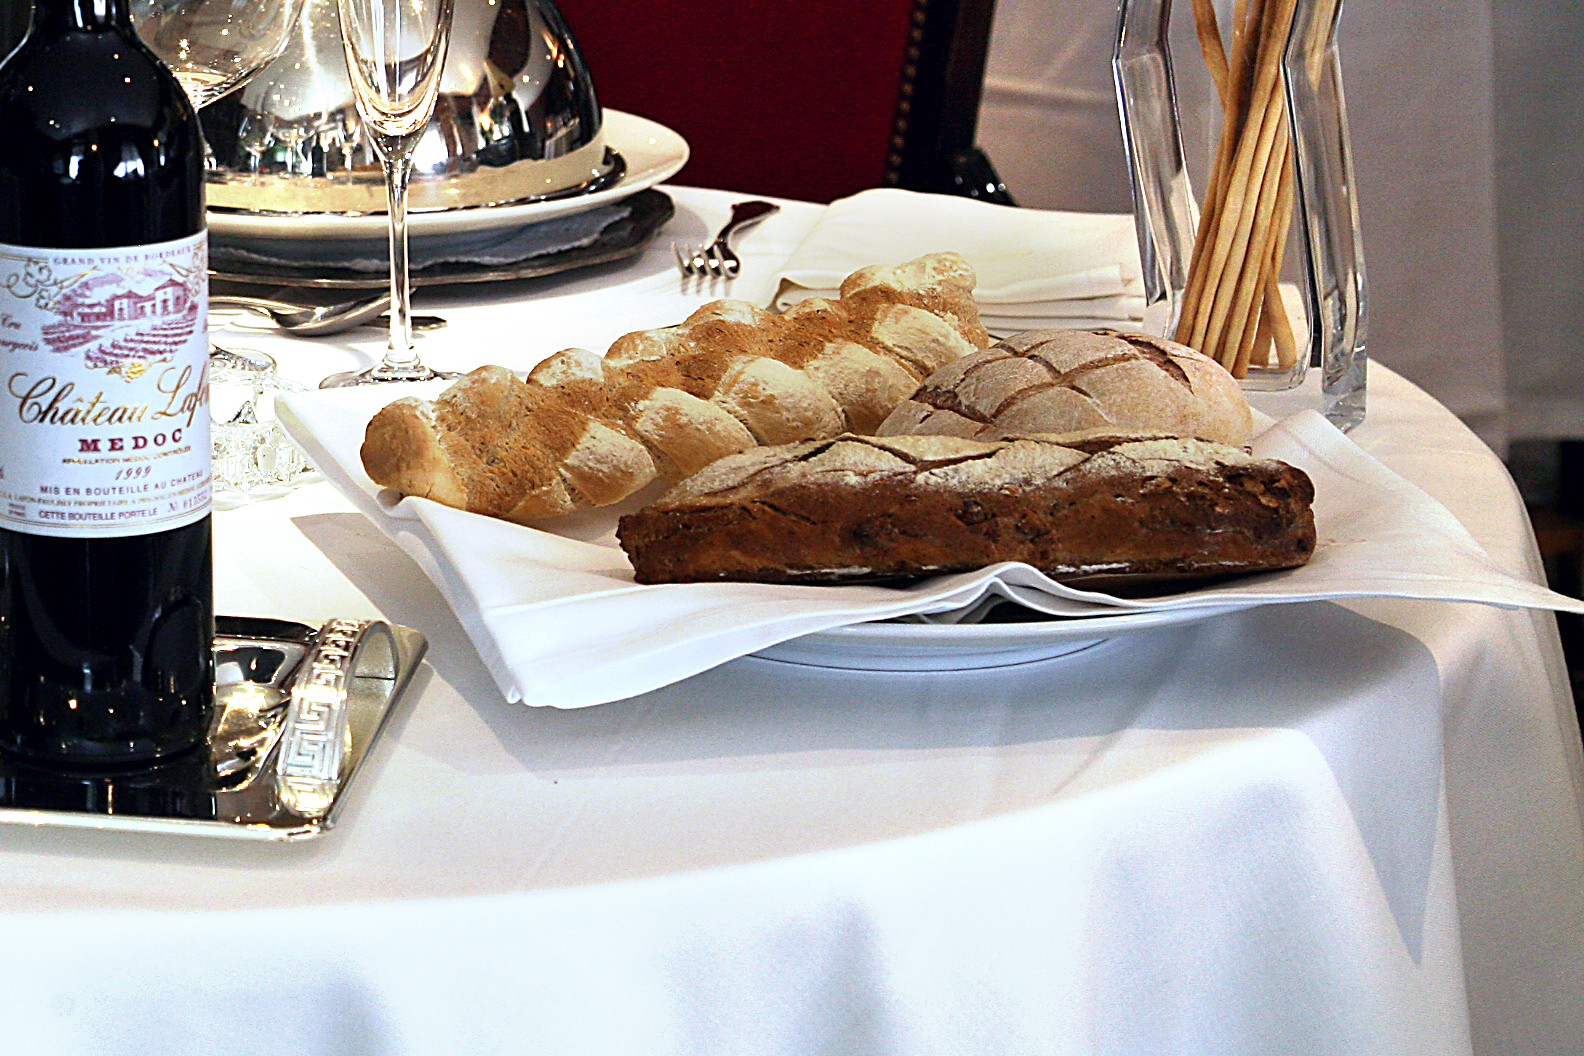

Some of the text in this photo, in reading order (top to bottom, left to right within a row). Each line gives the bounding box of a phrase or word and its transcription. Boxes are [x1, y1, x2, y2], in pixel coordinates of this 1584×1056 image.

[52, 257, 95, 266] GRAND
[99, 257, 120, 265] VIN
[125, 255, 139, 263] DE
[0, 313, 22, 330] Cru
[8, 372, 148, 425] Château
[78, 428, 183, 452] MEDOC
[115, 466, 152, 481] 1999
[40, 485, 60, 496] MIS
[65, 487, 81, 496] EN
[85, 484, 149, 496] BOUTEILLE
[154, 481, 167, 491] AU
[38, 507, 158, 521] CETTE BOUTEILLE PORTE LE
